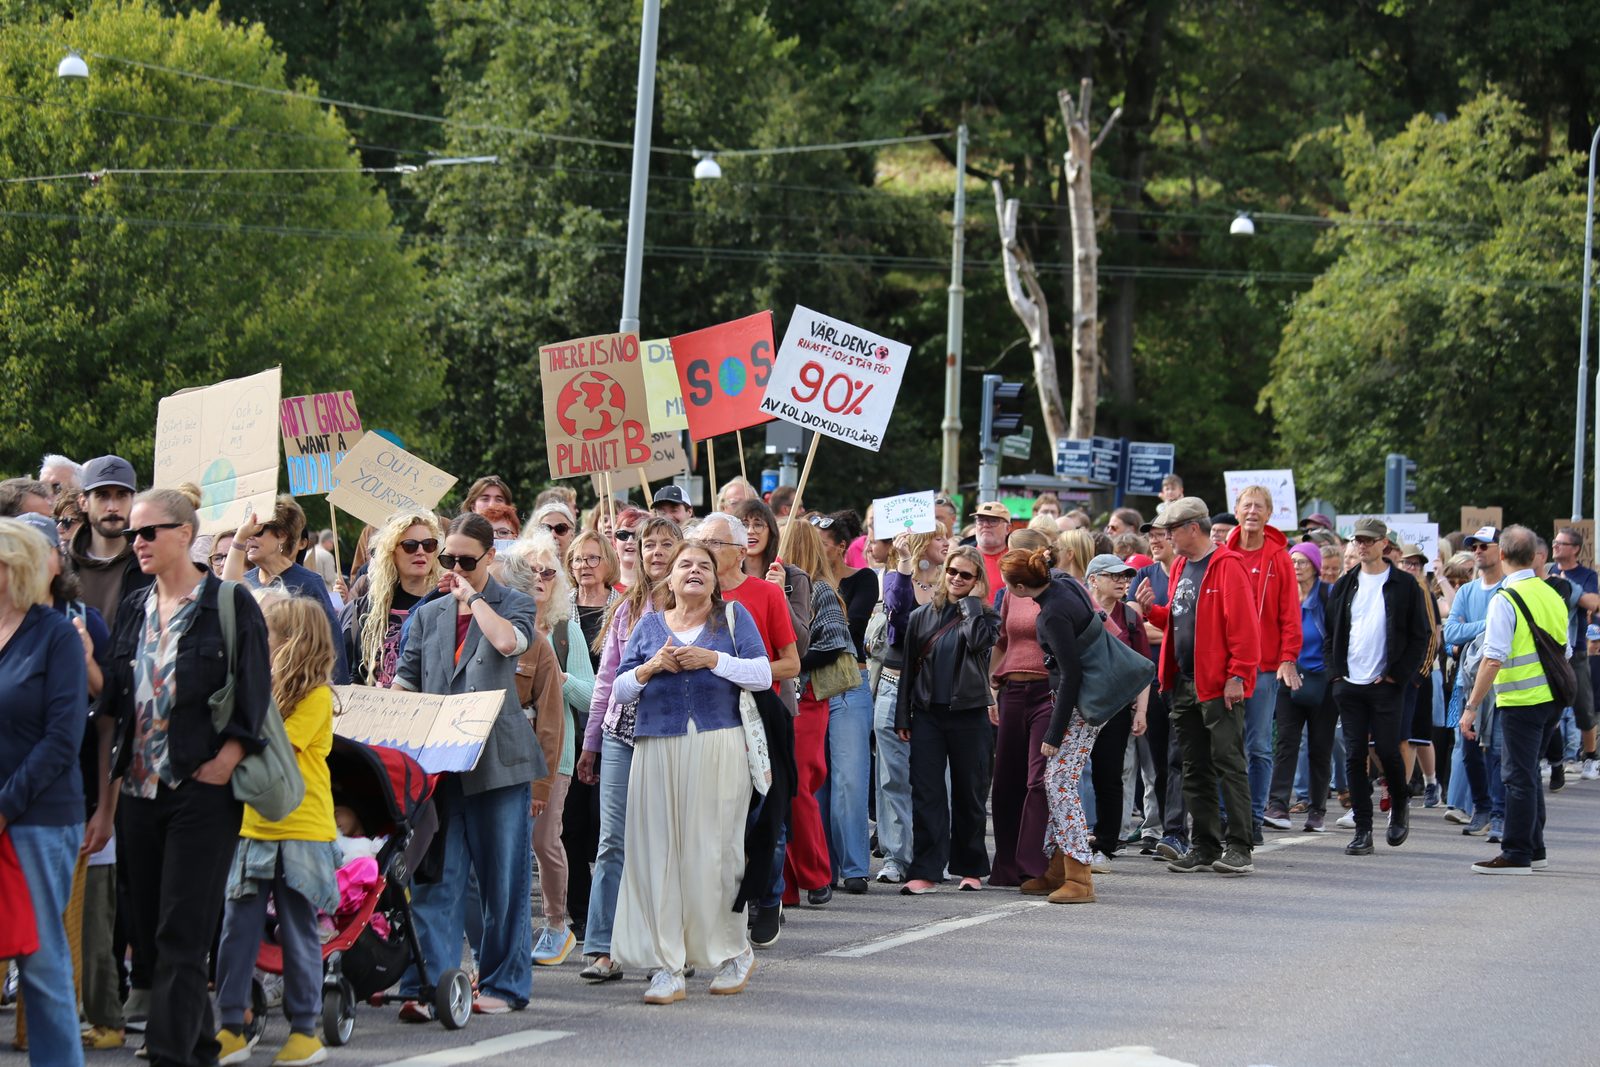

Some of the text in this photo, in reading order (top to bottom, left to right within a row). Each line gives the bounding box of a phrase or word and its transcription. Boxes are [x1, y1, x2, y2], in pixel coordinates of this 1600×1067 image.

[541, 334, 639, 373] THERE IS NO
[797, 337, 832, 357] RIKASTE
[810, 321, 877, 357] VÄRLDENS
[761, 397, 780, 413] AV
[791, 360, 875, 416] 90%
[280, 391, 361, 438] HOT GIRLS
[295, 433, 347, 455] WANT A
[556, 419, 652, 476] PLANET B
[287, 454, 320, 497] COLD
[376, 450, 420, 483] OUR
